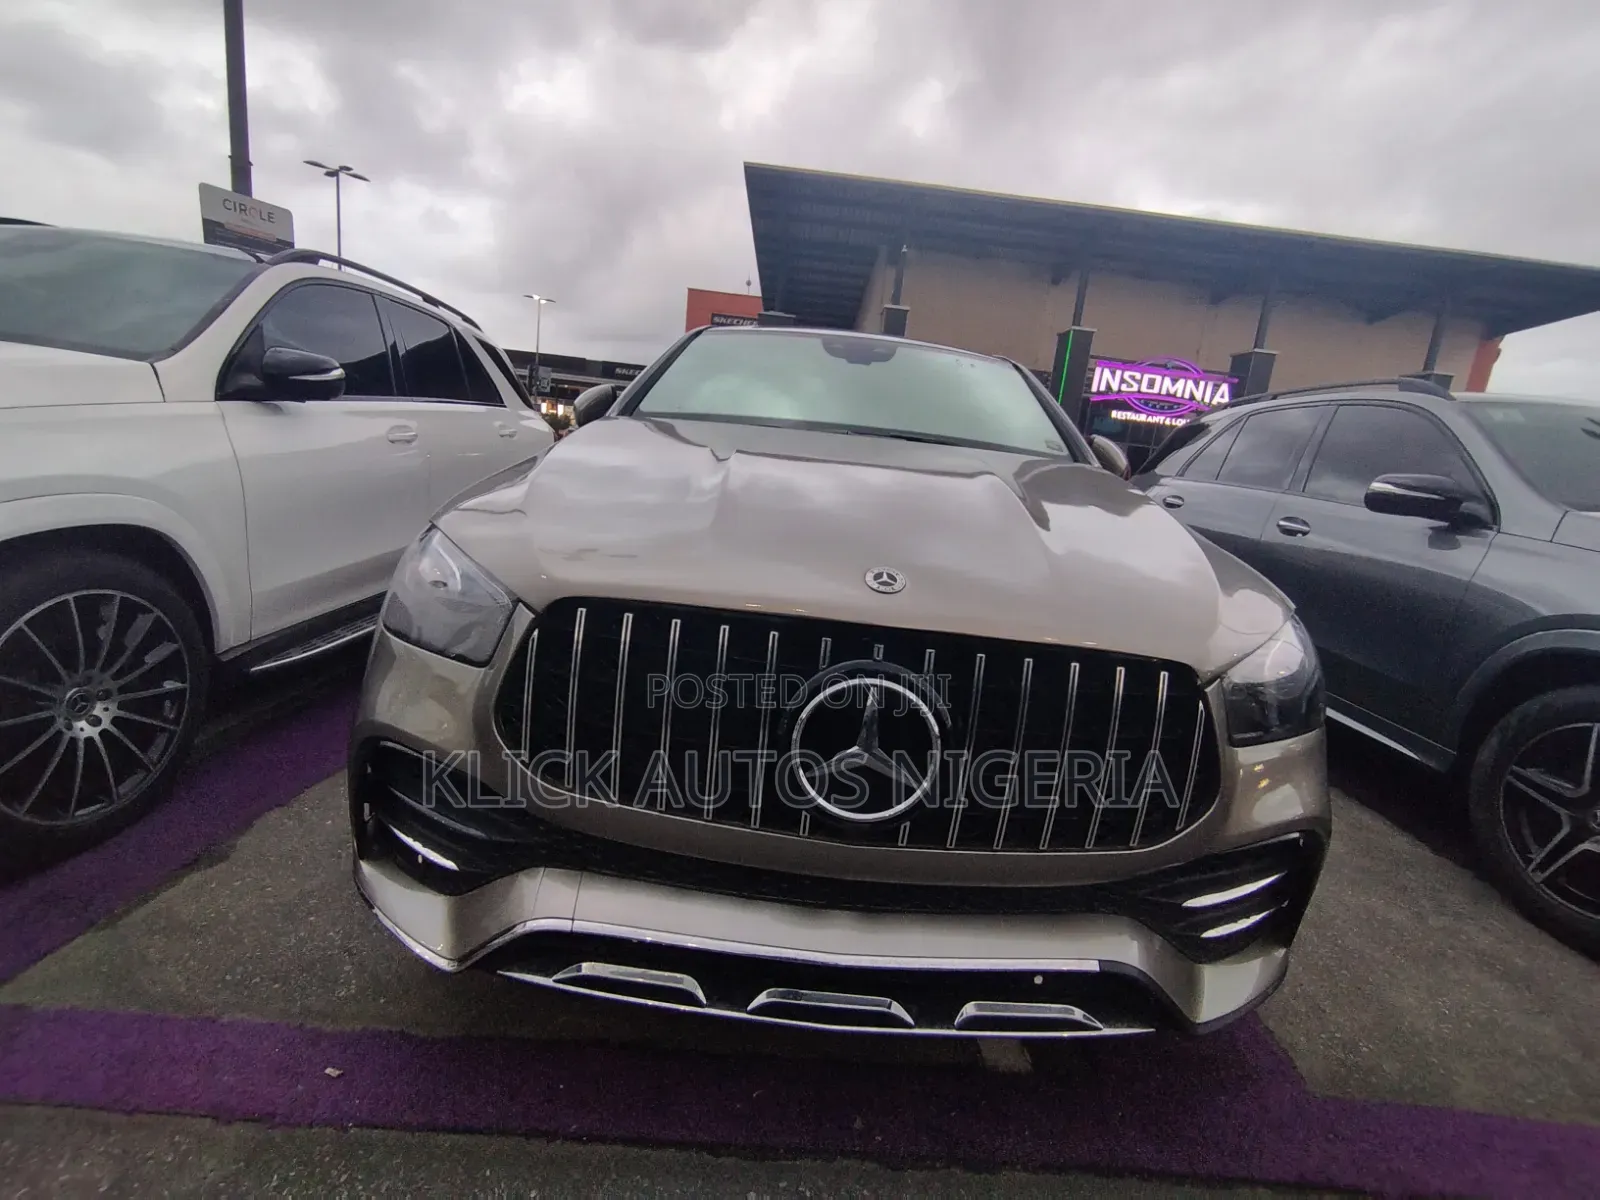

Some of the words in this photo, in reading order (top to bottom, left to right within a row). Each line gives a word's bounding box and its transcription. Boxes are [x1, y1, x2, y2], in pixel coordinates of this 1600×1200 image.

[222, 198, 276, 224] CIRCLE
[1091, 366, 1230, 405] INSOMNIA
[1111, 410, 1165, 425] RESTAURANT
